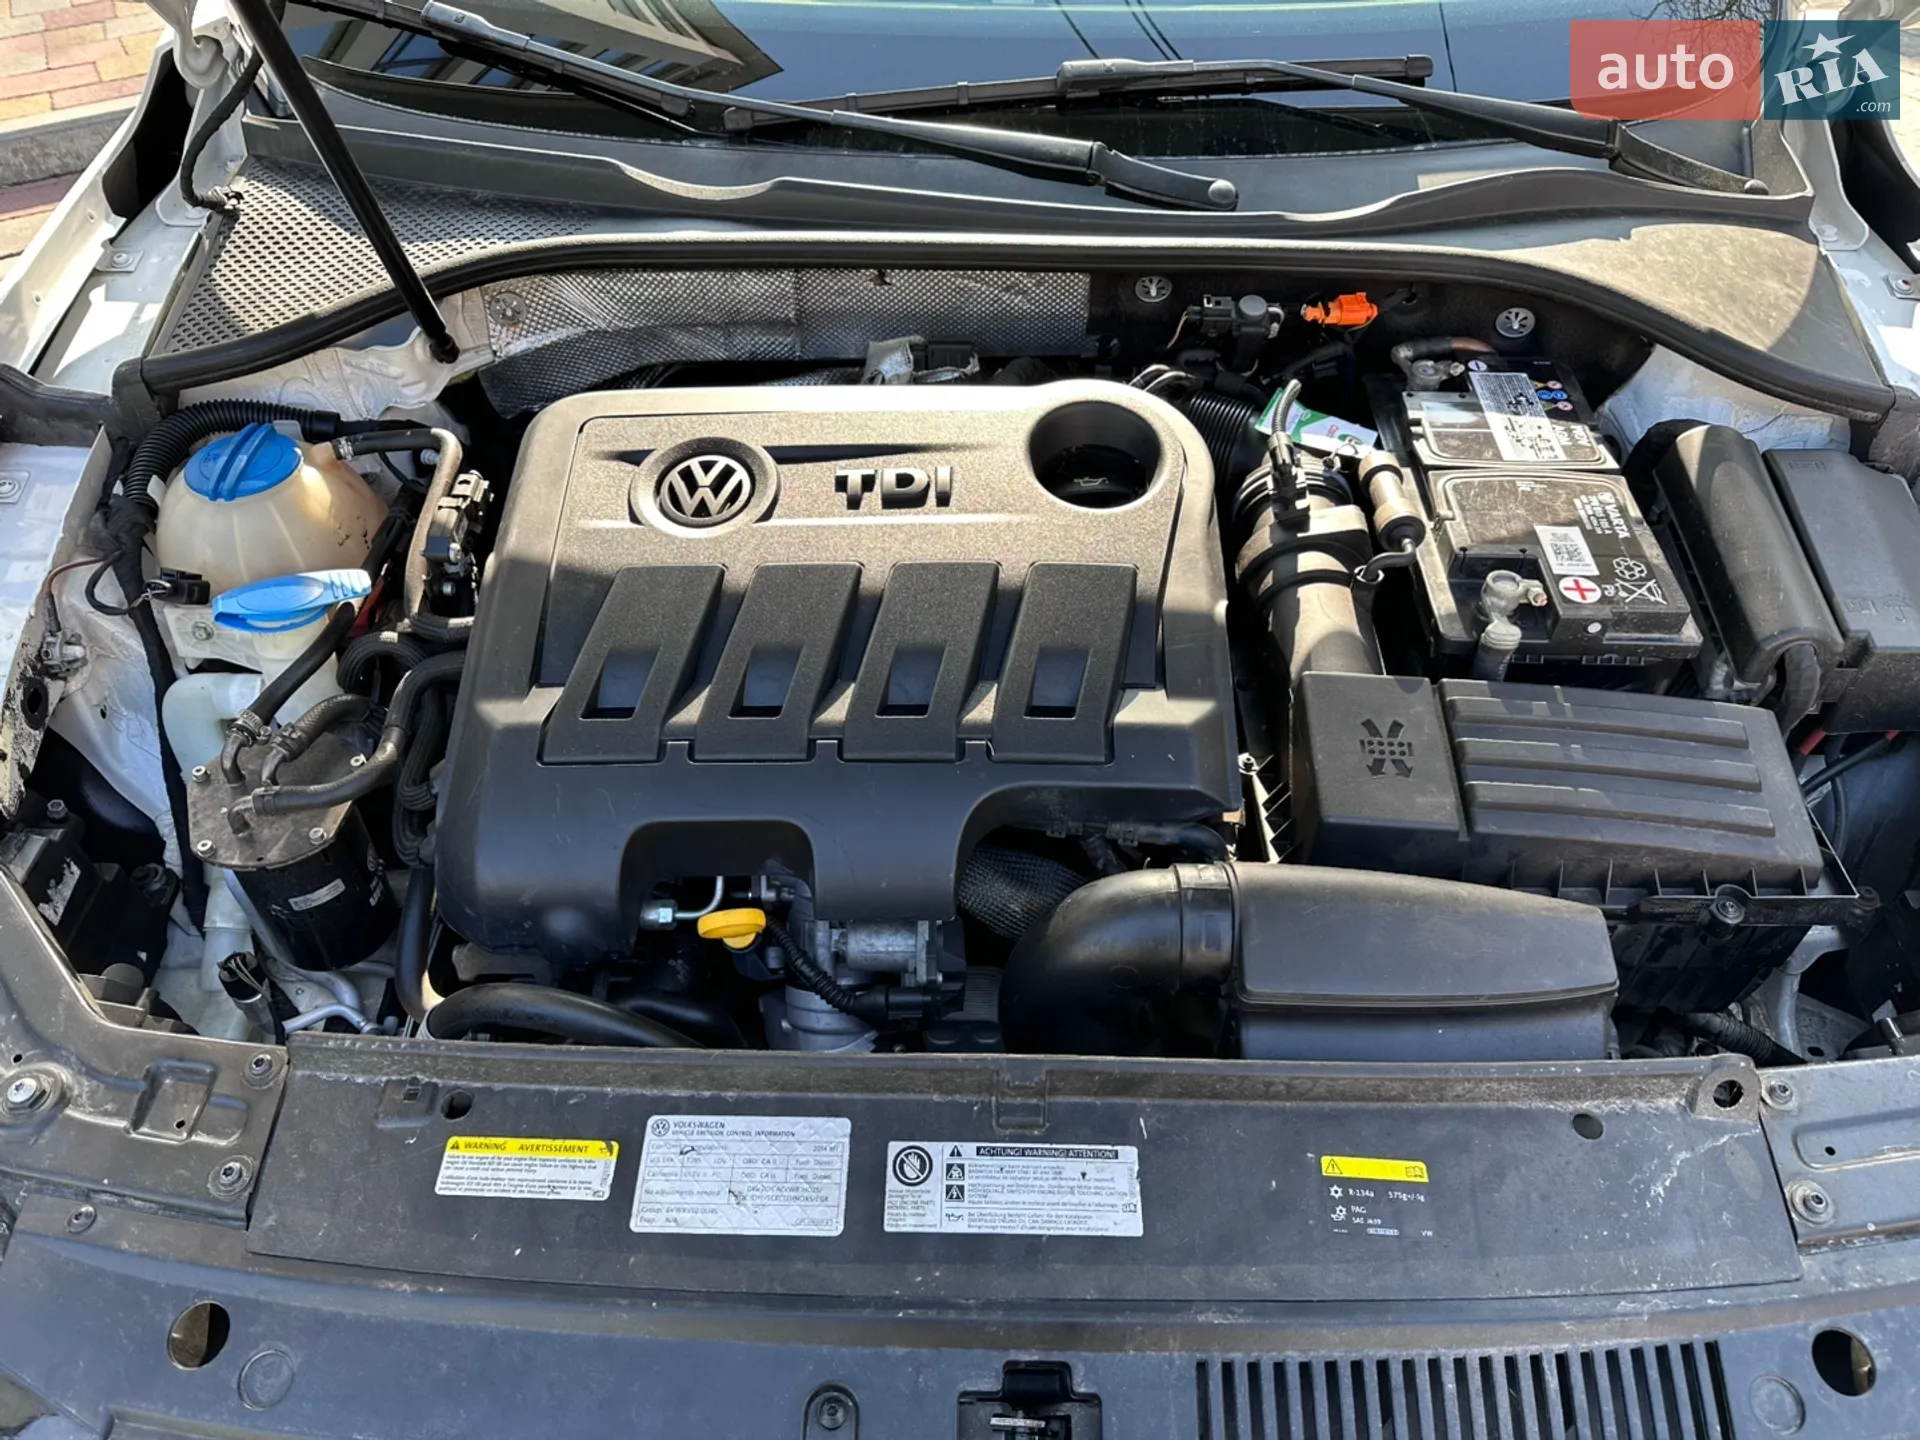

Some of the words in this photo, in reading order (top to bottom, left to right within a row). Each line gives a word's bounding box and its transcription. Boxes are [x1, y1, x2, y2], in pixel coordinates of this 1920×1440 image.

[835, 466, 953, 510] TDI
[1605, 504, 1631, 538] VARTA
[1601, 584, 1616, 597] Pb
[464, 1142, 507, 1151] WARNING
[517, 1144, 589, 1154] AVERTISSEMENT
[979, 1148, 1022, 1156] ACHTUNG!
[1024, 1149, 1067, 1158] WARNING!
[1068, 1150, 1116, 1159] ATTENTION!
[1351, 1205, 1367, 1214] PAG
